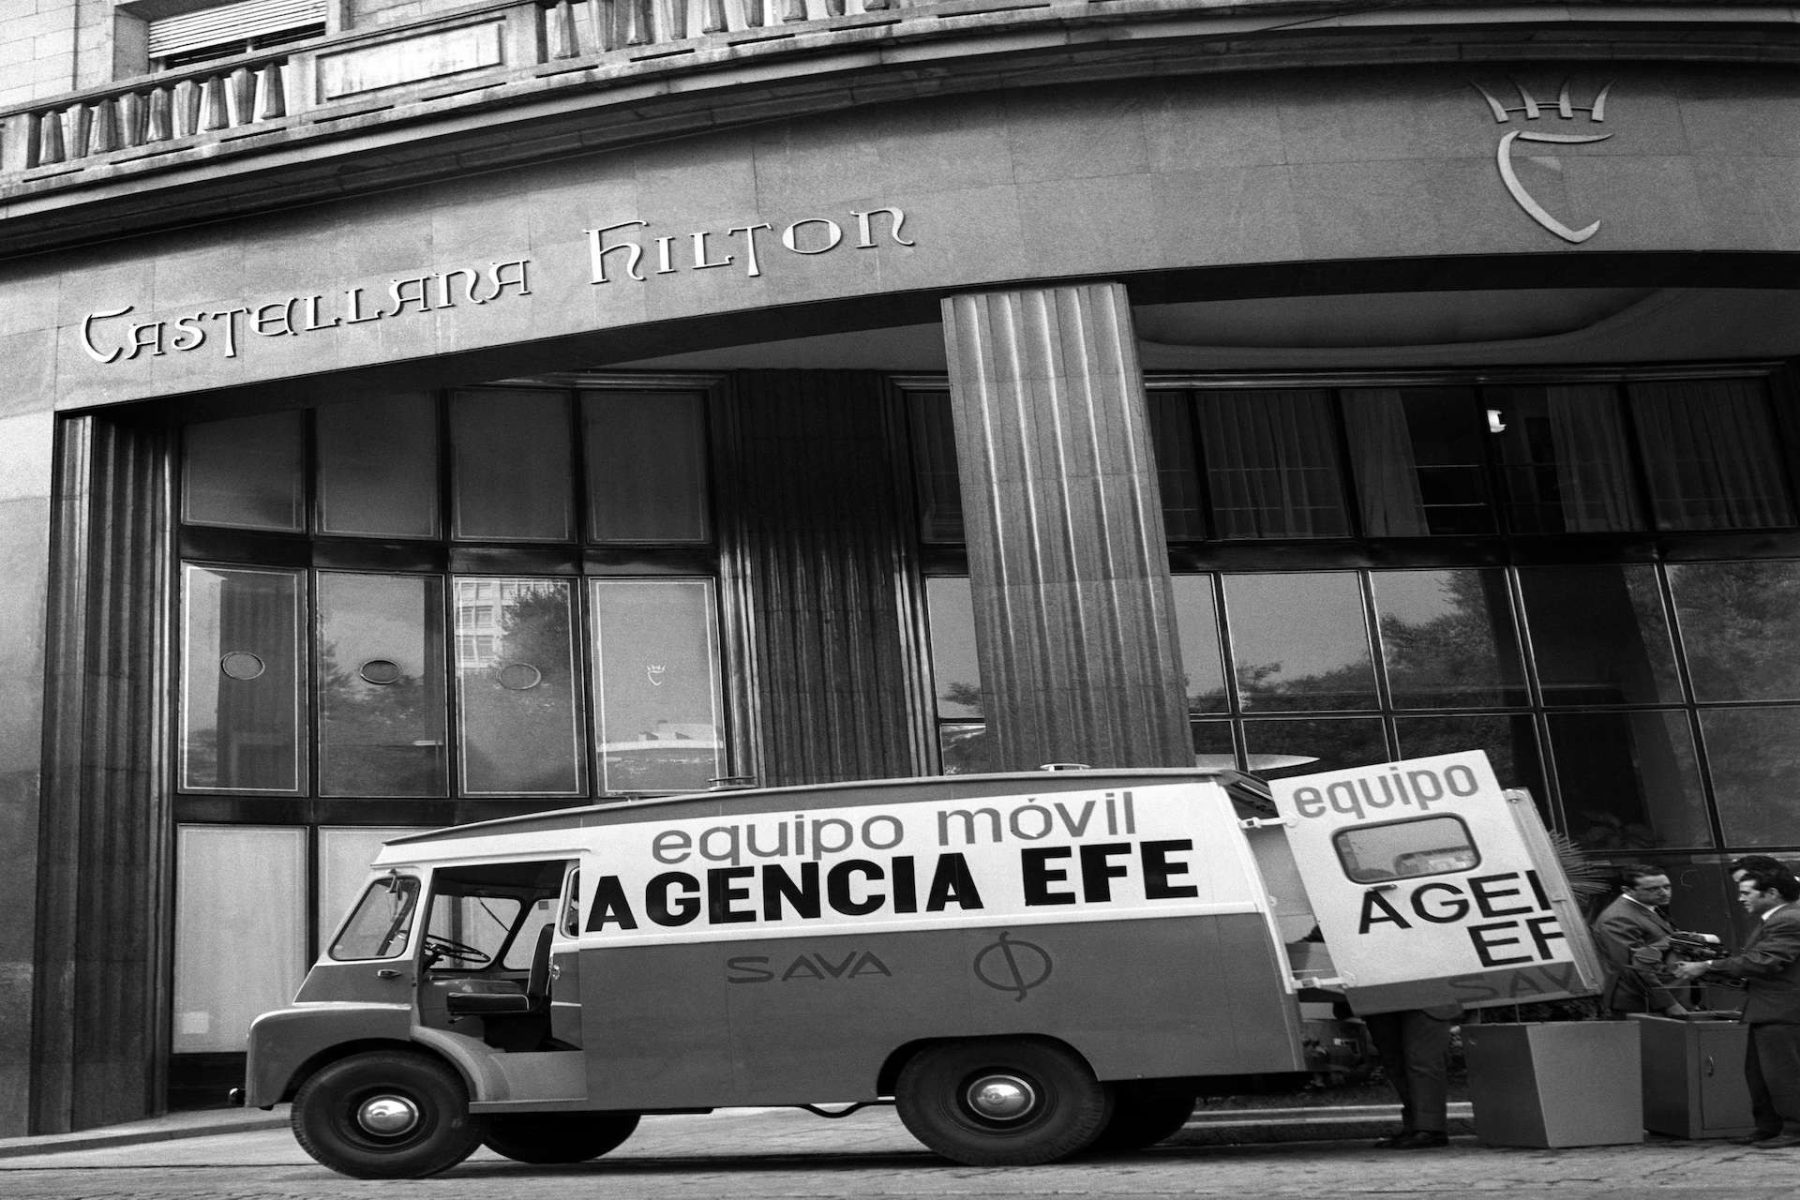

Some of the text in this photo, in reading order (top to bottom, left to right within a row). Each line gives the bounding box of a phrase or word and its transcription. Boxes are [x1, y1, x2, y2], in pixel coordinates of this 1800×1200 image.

[583, 206, 914, 285] HILTON
[652, 791, 1136, 866] equipo móvil
[1293, 765, 1480, 819] equipo
[585, 839, 1198, 933] AGENCIA EFE
[726, 951, 893, 984] SAVA
